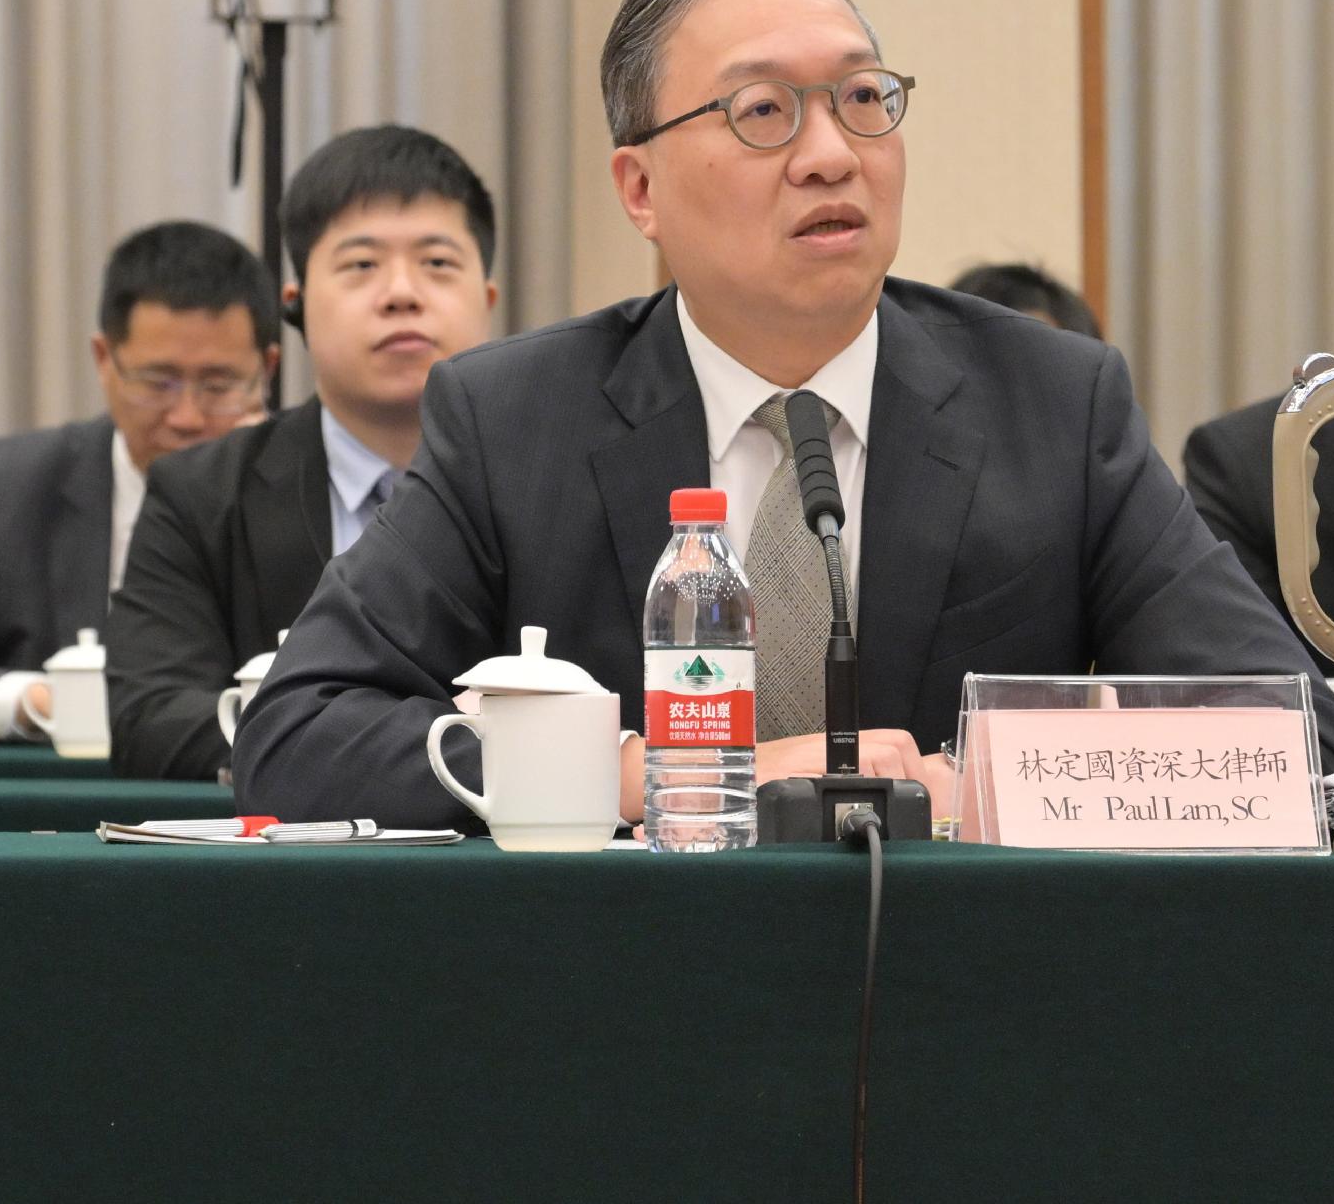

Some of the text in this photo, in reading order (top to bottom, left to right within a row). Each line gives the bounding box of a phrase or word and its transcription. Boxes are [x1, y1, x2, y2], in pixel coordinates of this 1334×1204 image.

[669, 701, 731, 719] 农夫山泉
[703, 720, 731, 730] SPRING
[1016, 746, 1287, 784] 林定國資深大律師
[1041, 795, 1083, 821] Mr
[1103, 795, 1161, 821] Paul
[1231, 795, 1271, 821] SC
